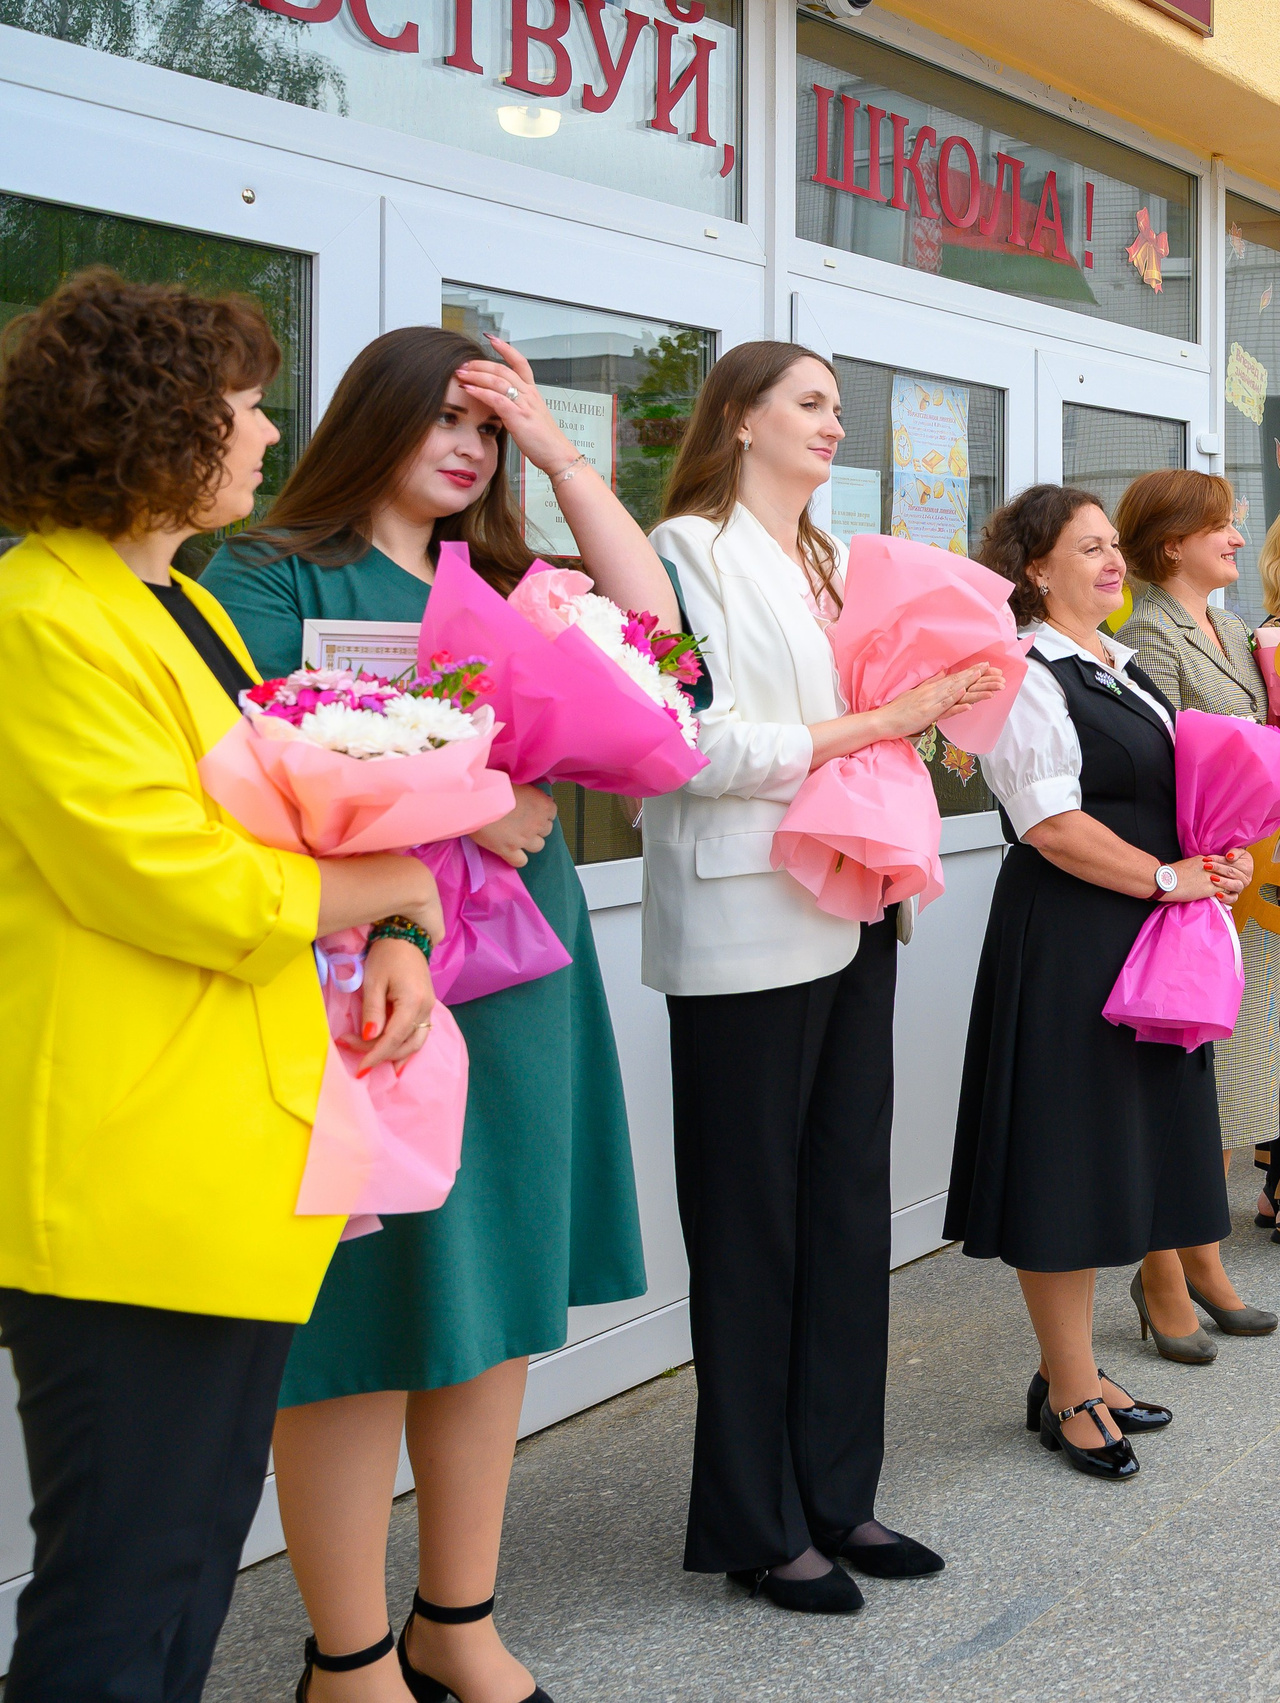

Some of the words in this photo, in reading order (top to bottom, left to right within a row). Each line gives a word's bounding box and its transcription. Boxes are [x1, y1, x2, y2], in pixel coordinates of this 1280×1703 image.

[810, 83, 1095, 269] ШКОЛА!
[545, 398, 605, 417] НИМАНИЕ!
[559, 418, 578, 432] Вход
